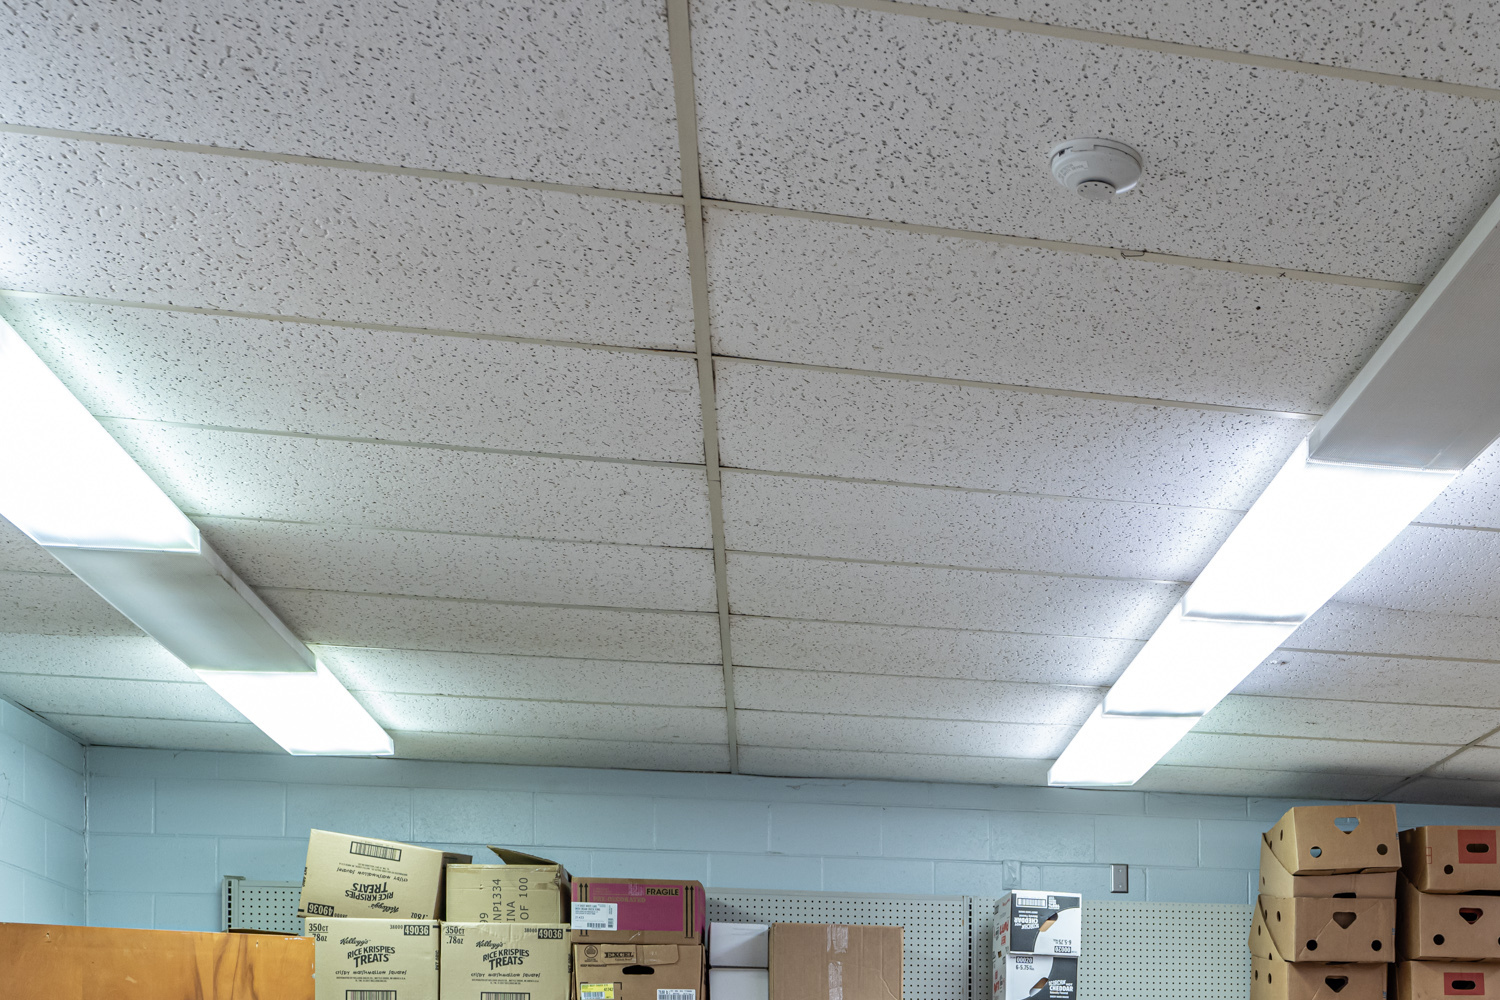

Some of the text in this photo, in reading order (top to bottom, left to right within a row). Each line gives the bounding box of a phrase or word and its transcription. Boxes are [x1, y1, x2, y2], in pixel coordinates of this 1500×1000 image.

[352, 882, 388, 893] TREATS
[518, 877, 528, 900] 100
[646, 888, 679, 896] FRAGILE
[345, 890, 394, 901] RICE KRISPIES
[308, 903, 333, 916] 49036
[404, 926, 429, 935] 49036
[538, 929, 562, 939] 49036
[348, 946, 395, 959] RICE KRISPIES
[483, 949, 529, 962] RICE KRISPIES
[353, 954, 389, 968] TREATS
[489, 956, 523, 970] TREATS
